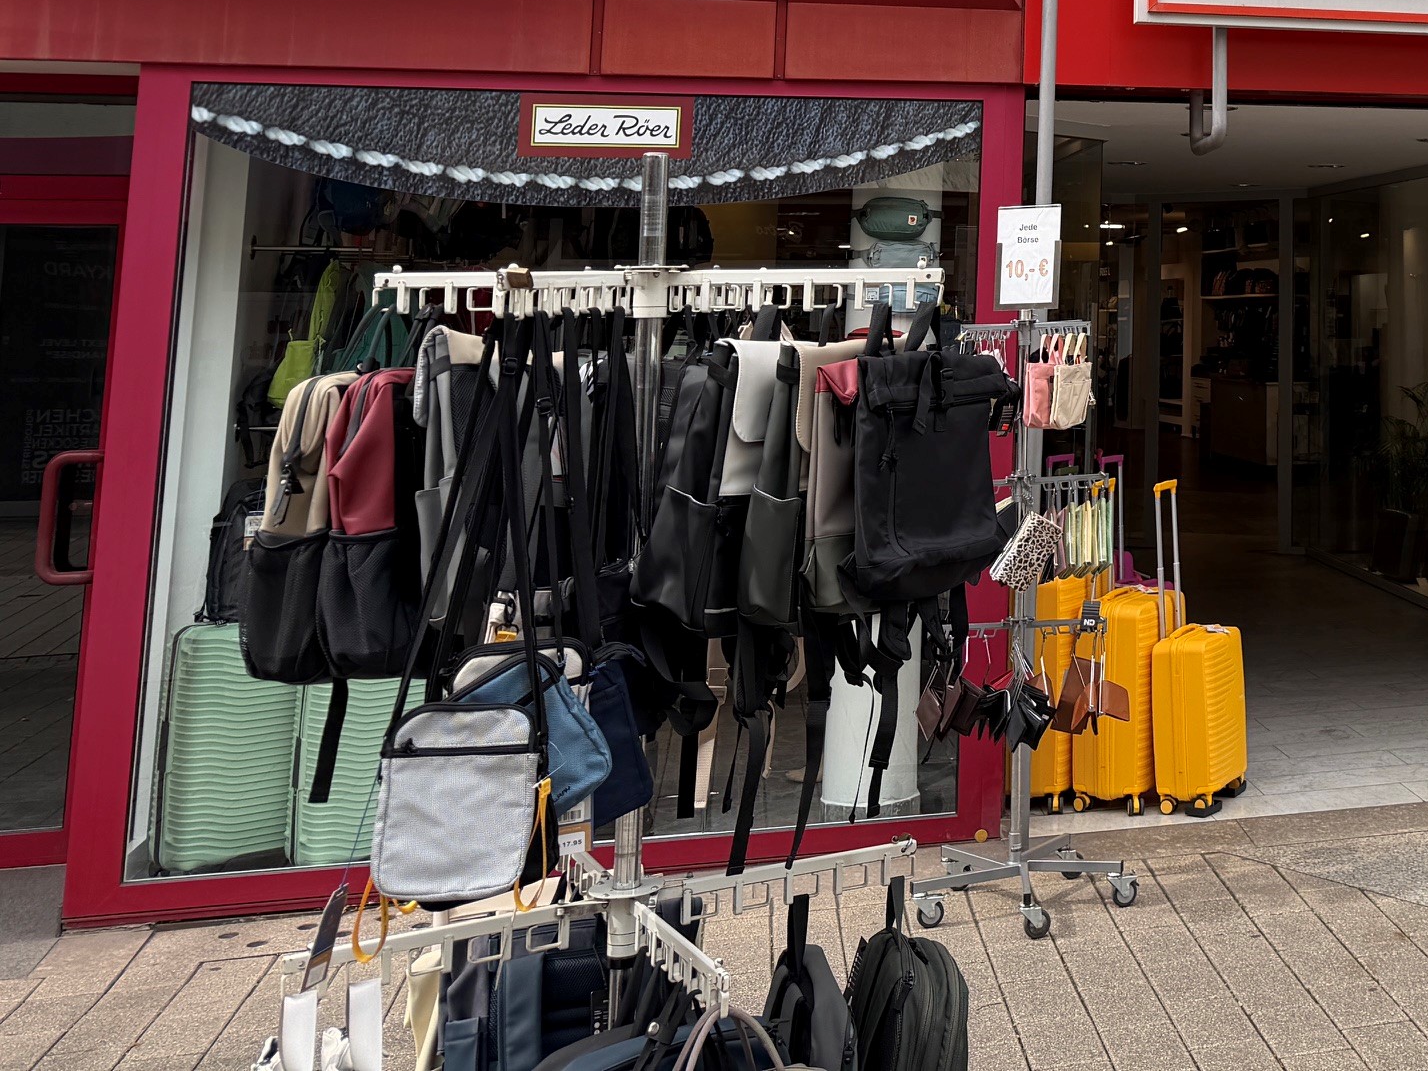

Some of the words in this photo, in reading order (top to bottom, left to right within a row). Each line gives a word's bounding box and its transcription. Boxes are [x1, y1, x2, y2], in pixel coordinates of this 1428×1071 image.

[538, 114, 610, 138] Leder
[613, 115, 673, 139] Röer
[1005, 259, 1035, 281] 10,-
[1038, 258, 1049, 277] €
